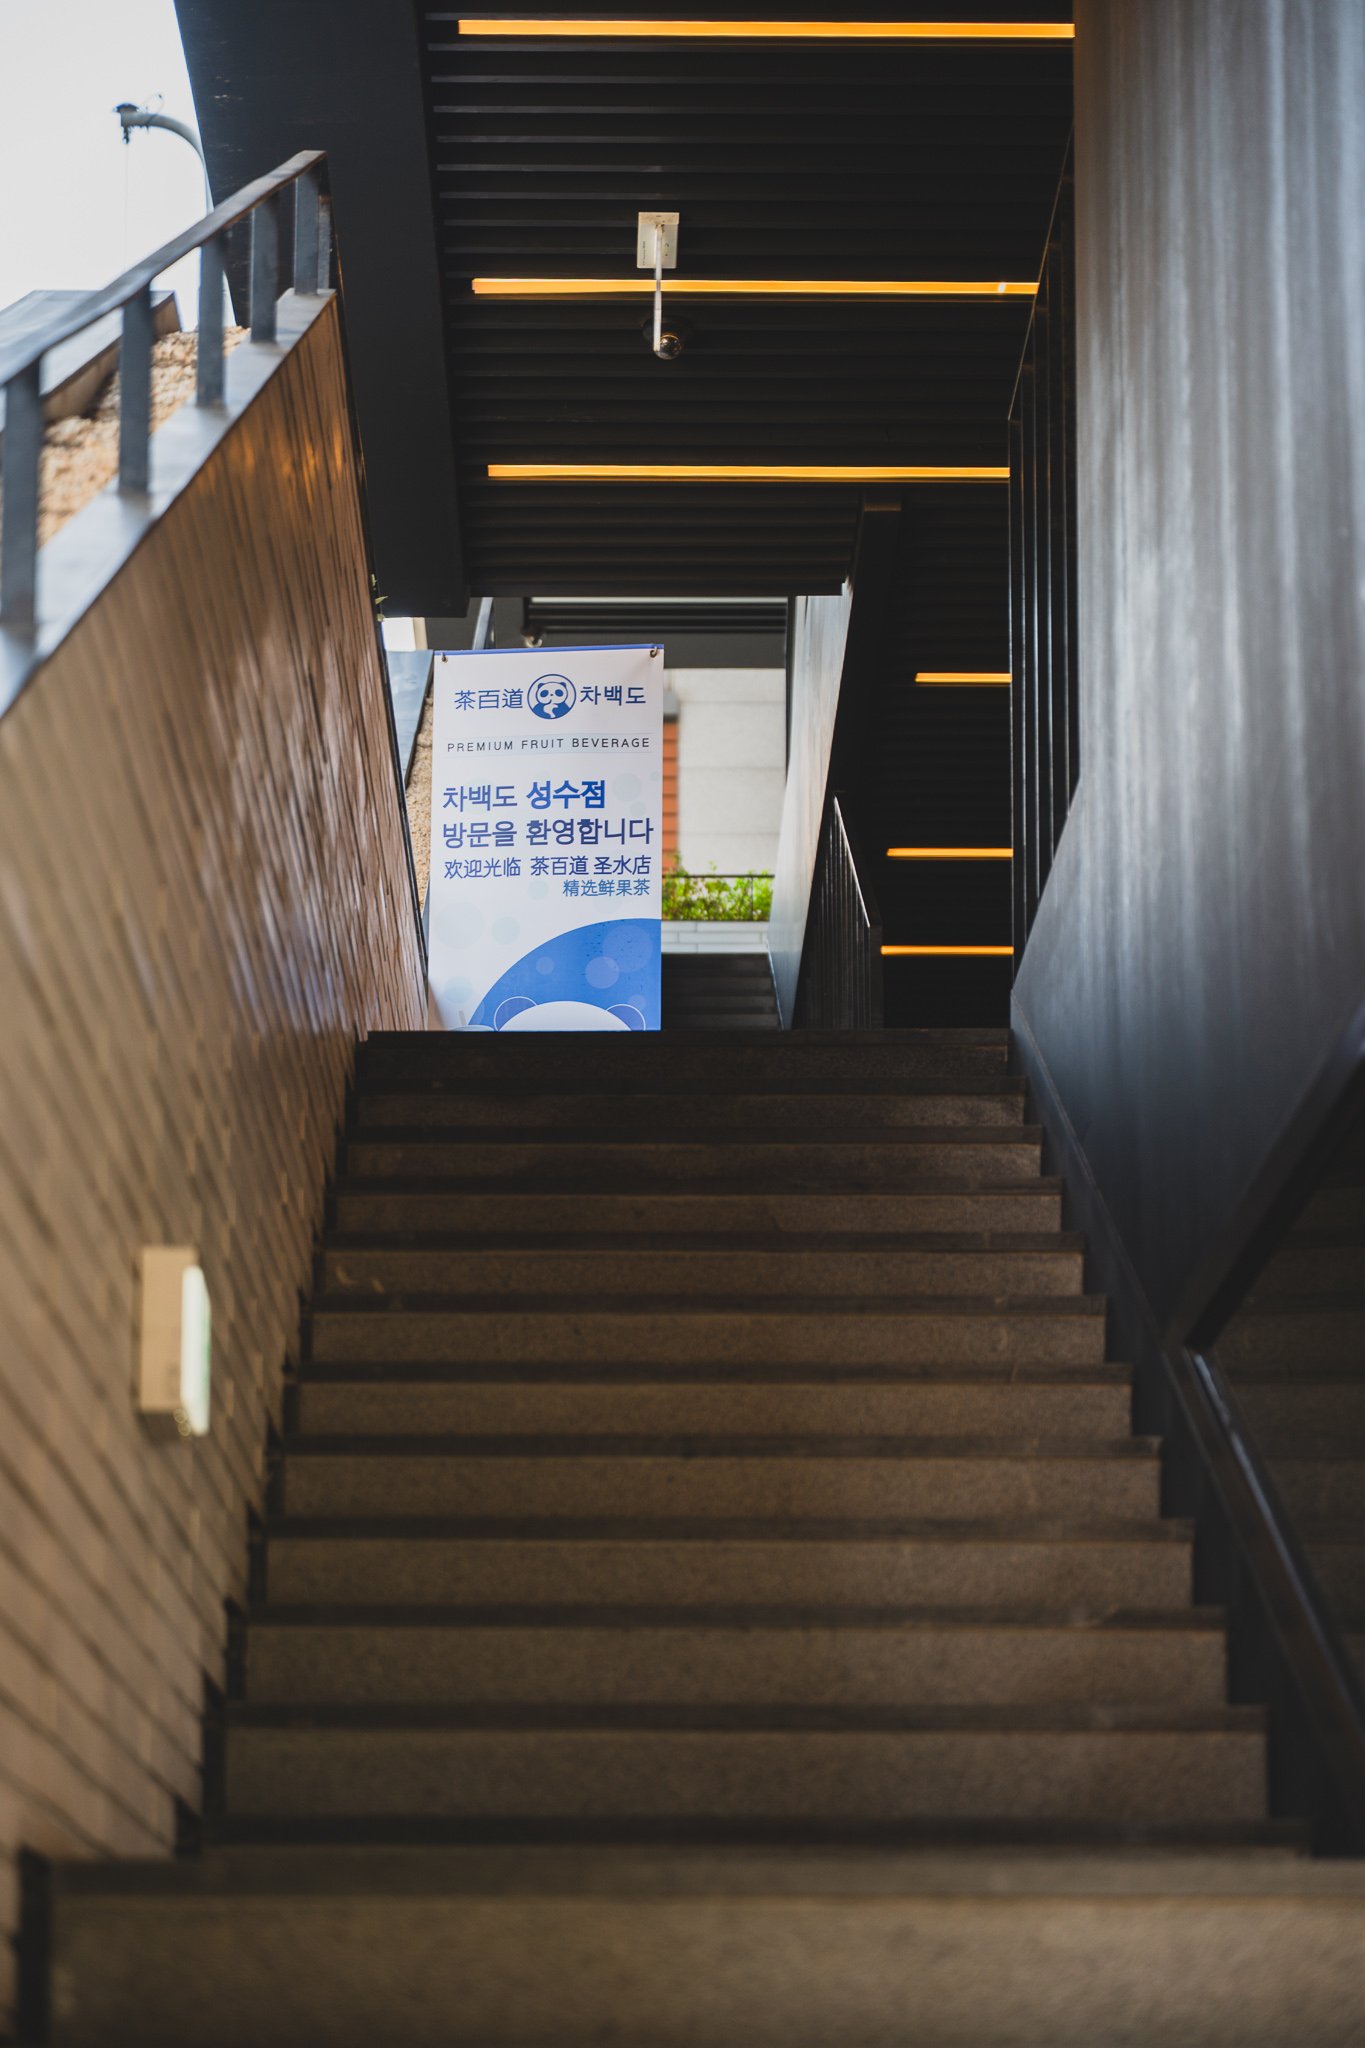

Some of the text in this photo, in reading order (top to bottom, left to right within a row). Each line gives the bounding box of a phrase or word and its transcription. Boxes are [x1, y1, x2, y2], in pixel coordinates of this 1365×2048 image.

[454, 687, 524, 711] 茶百道
[580, 685, 647, 706] 차백도
[447, 737, 650, 752] PREMIUM FRUIT BEVERAGE
[442, 779, 606, 813] 차백도 성수점
[443, 817, 654, 849] 방문을 환영합니다
[444, 855, 652, 880] 欢迎光临 茶百道 圣水店
[562, 878, 651, 898] 精选鲜果茶
